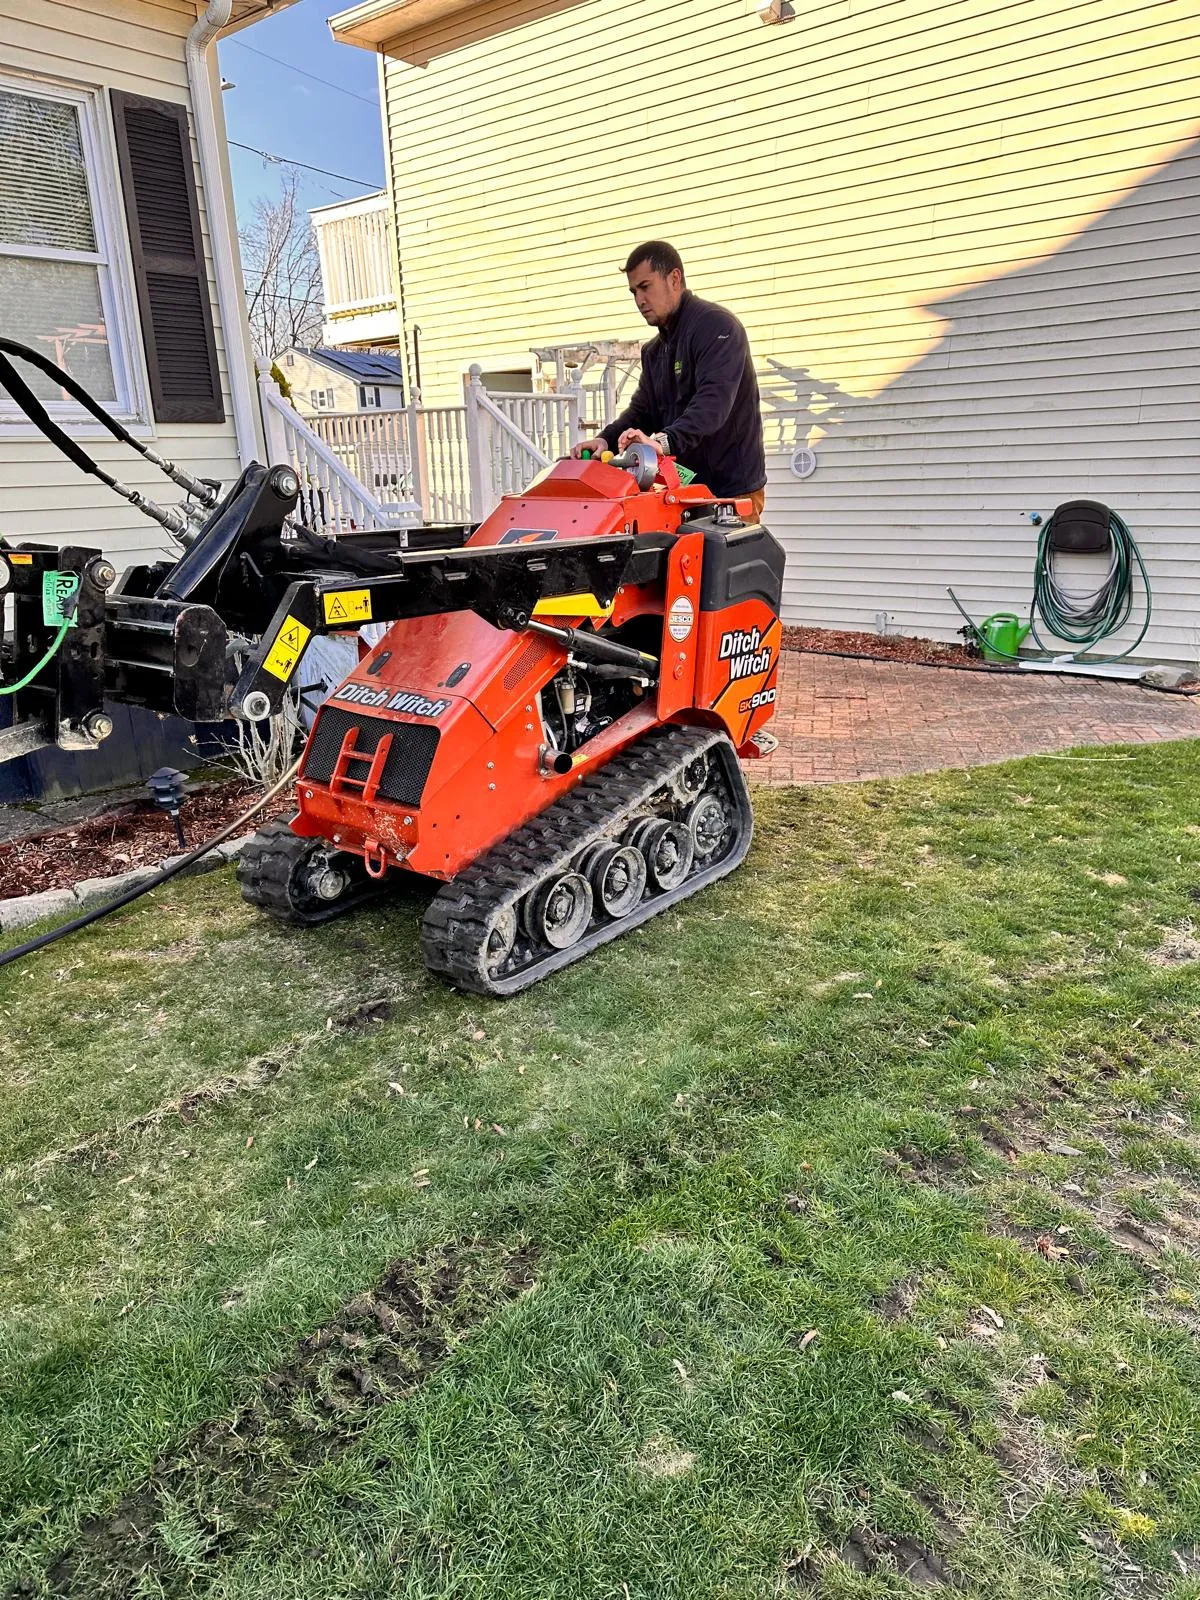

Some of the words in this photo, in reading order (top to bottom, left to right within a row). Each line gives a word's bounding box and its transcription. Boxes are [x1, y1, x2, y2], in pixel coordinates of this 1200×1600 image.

[719, 627, 761, 659] Ditch
[729, 649, 771, 680] Witch
[333, 683, 390, 707] Ditch
[385, 691, 449, 718] Witch
[739, 688, 777, 712] SK900
